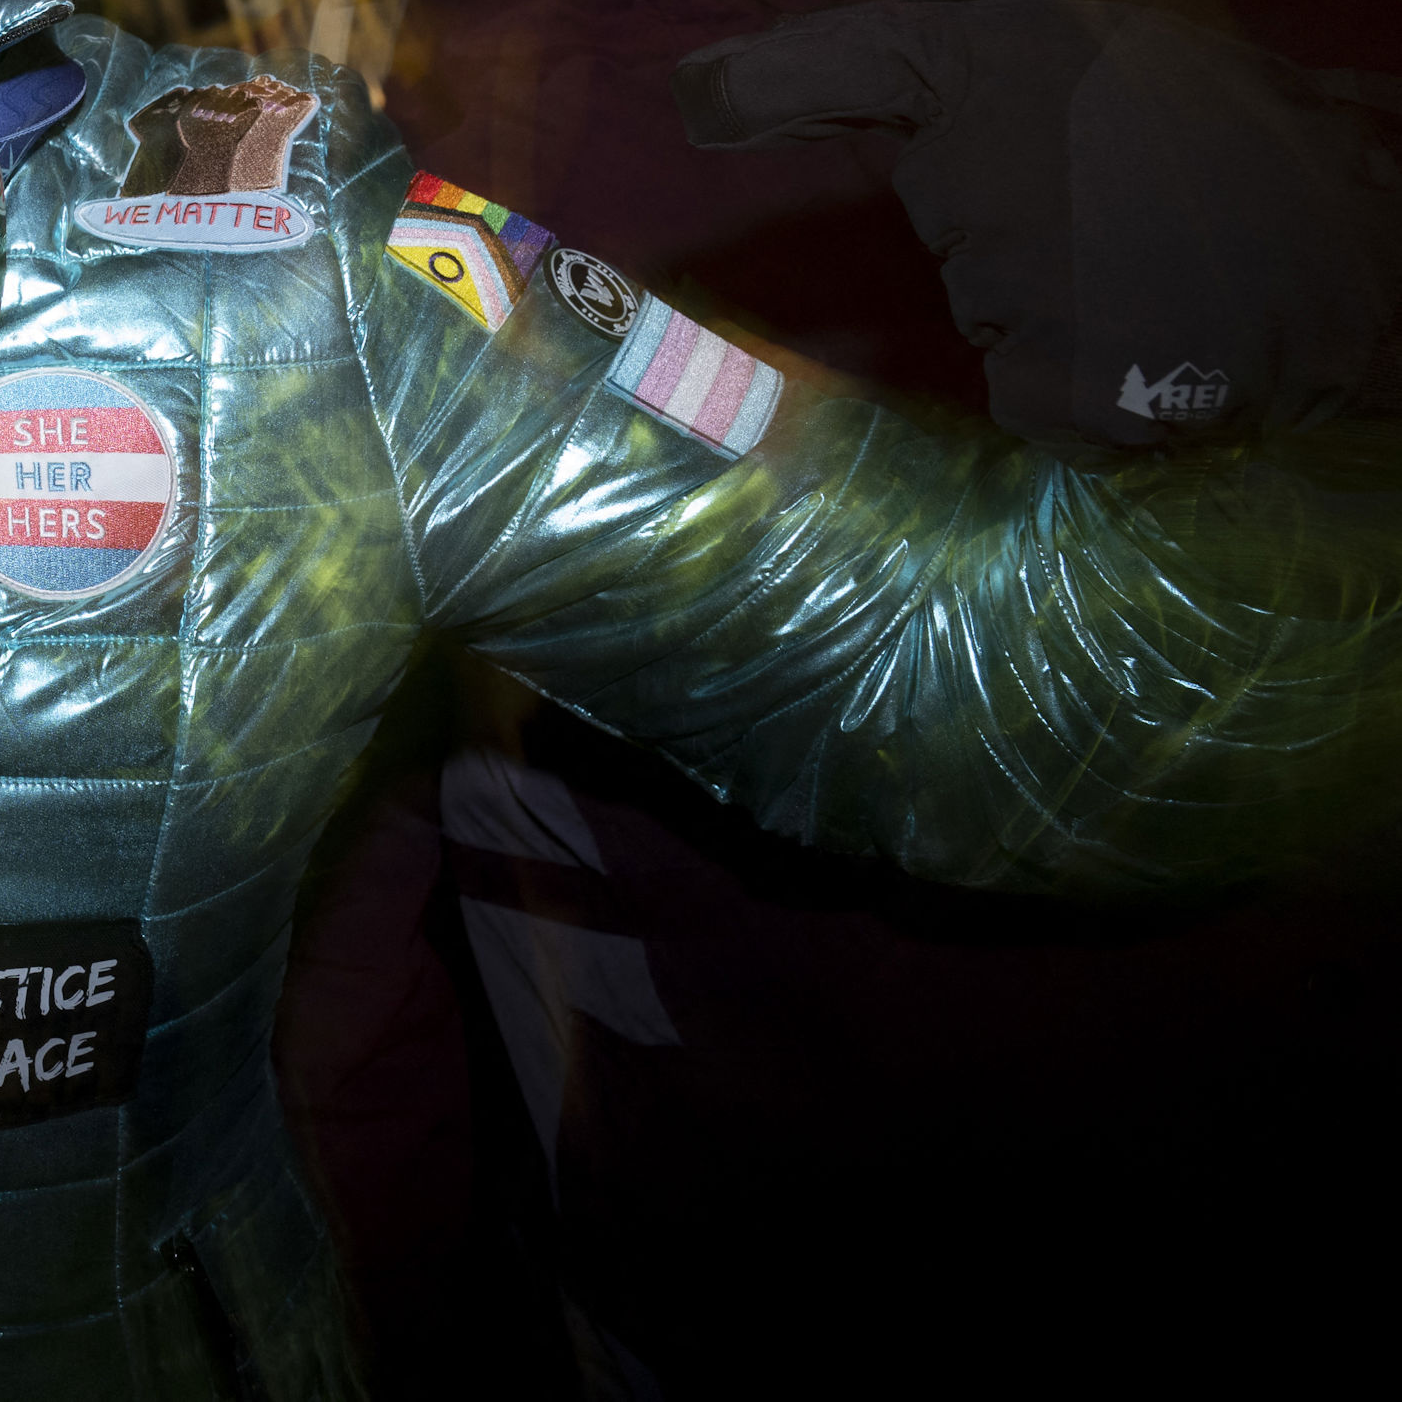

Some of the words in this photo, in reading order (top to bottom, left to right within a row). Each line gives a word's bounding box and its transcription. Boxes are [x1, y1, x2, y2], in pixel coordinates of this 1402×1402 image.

[104, 204, 150, 226] WE
[156, 201, 292, 235] MATTER
[1160, 383, 1229, 409] REI
[12, 416, 90, 448] SHE
[16, 462, 93, 493] HER
[7, 507, 107, 541] HERS
